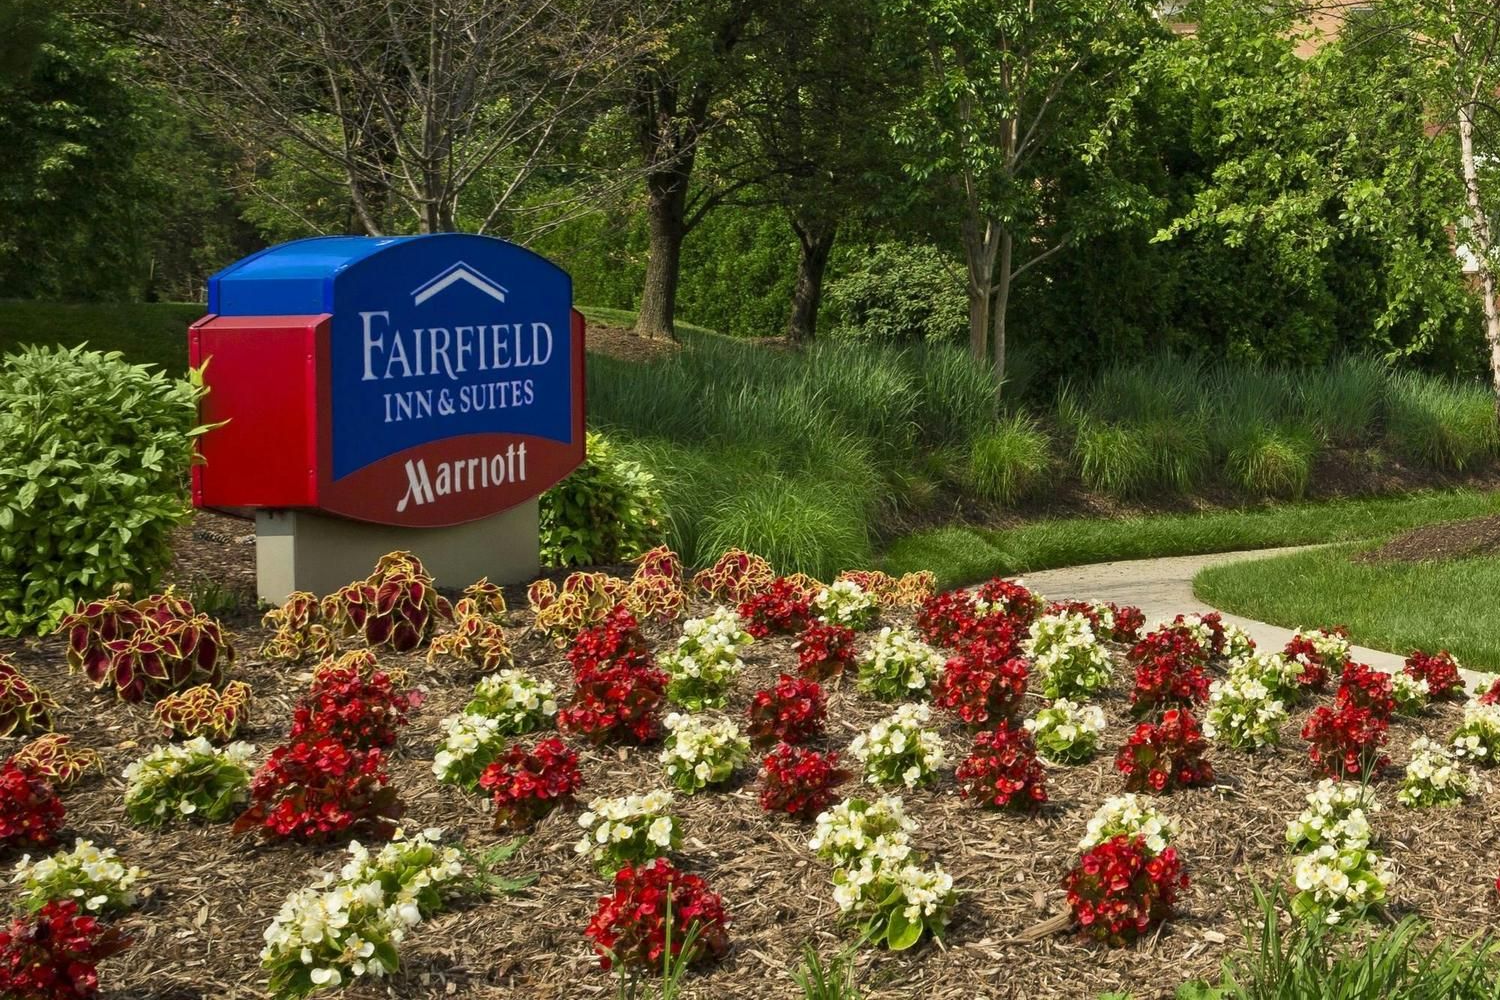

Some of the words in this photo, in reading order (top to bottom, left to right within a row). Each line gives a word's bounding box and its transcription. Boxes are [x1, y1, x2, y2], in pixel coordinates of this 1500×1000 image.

[358, 310, 553, 381] FAIRFIELD
[383, 388, 433, 423] INN
[459, 379, 535, 413] SUITES
[396, 441, 527, 513] Marriott
